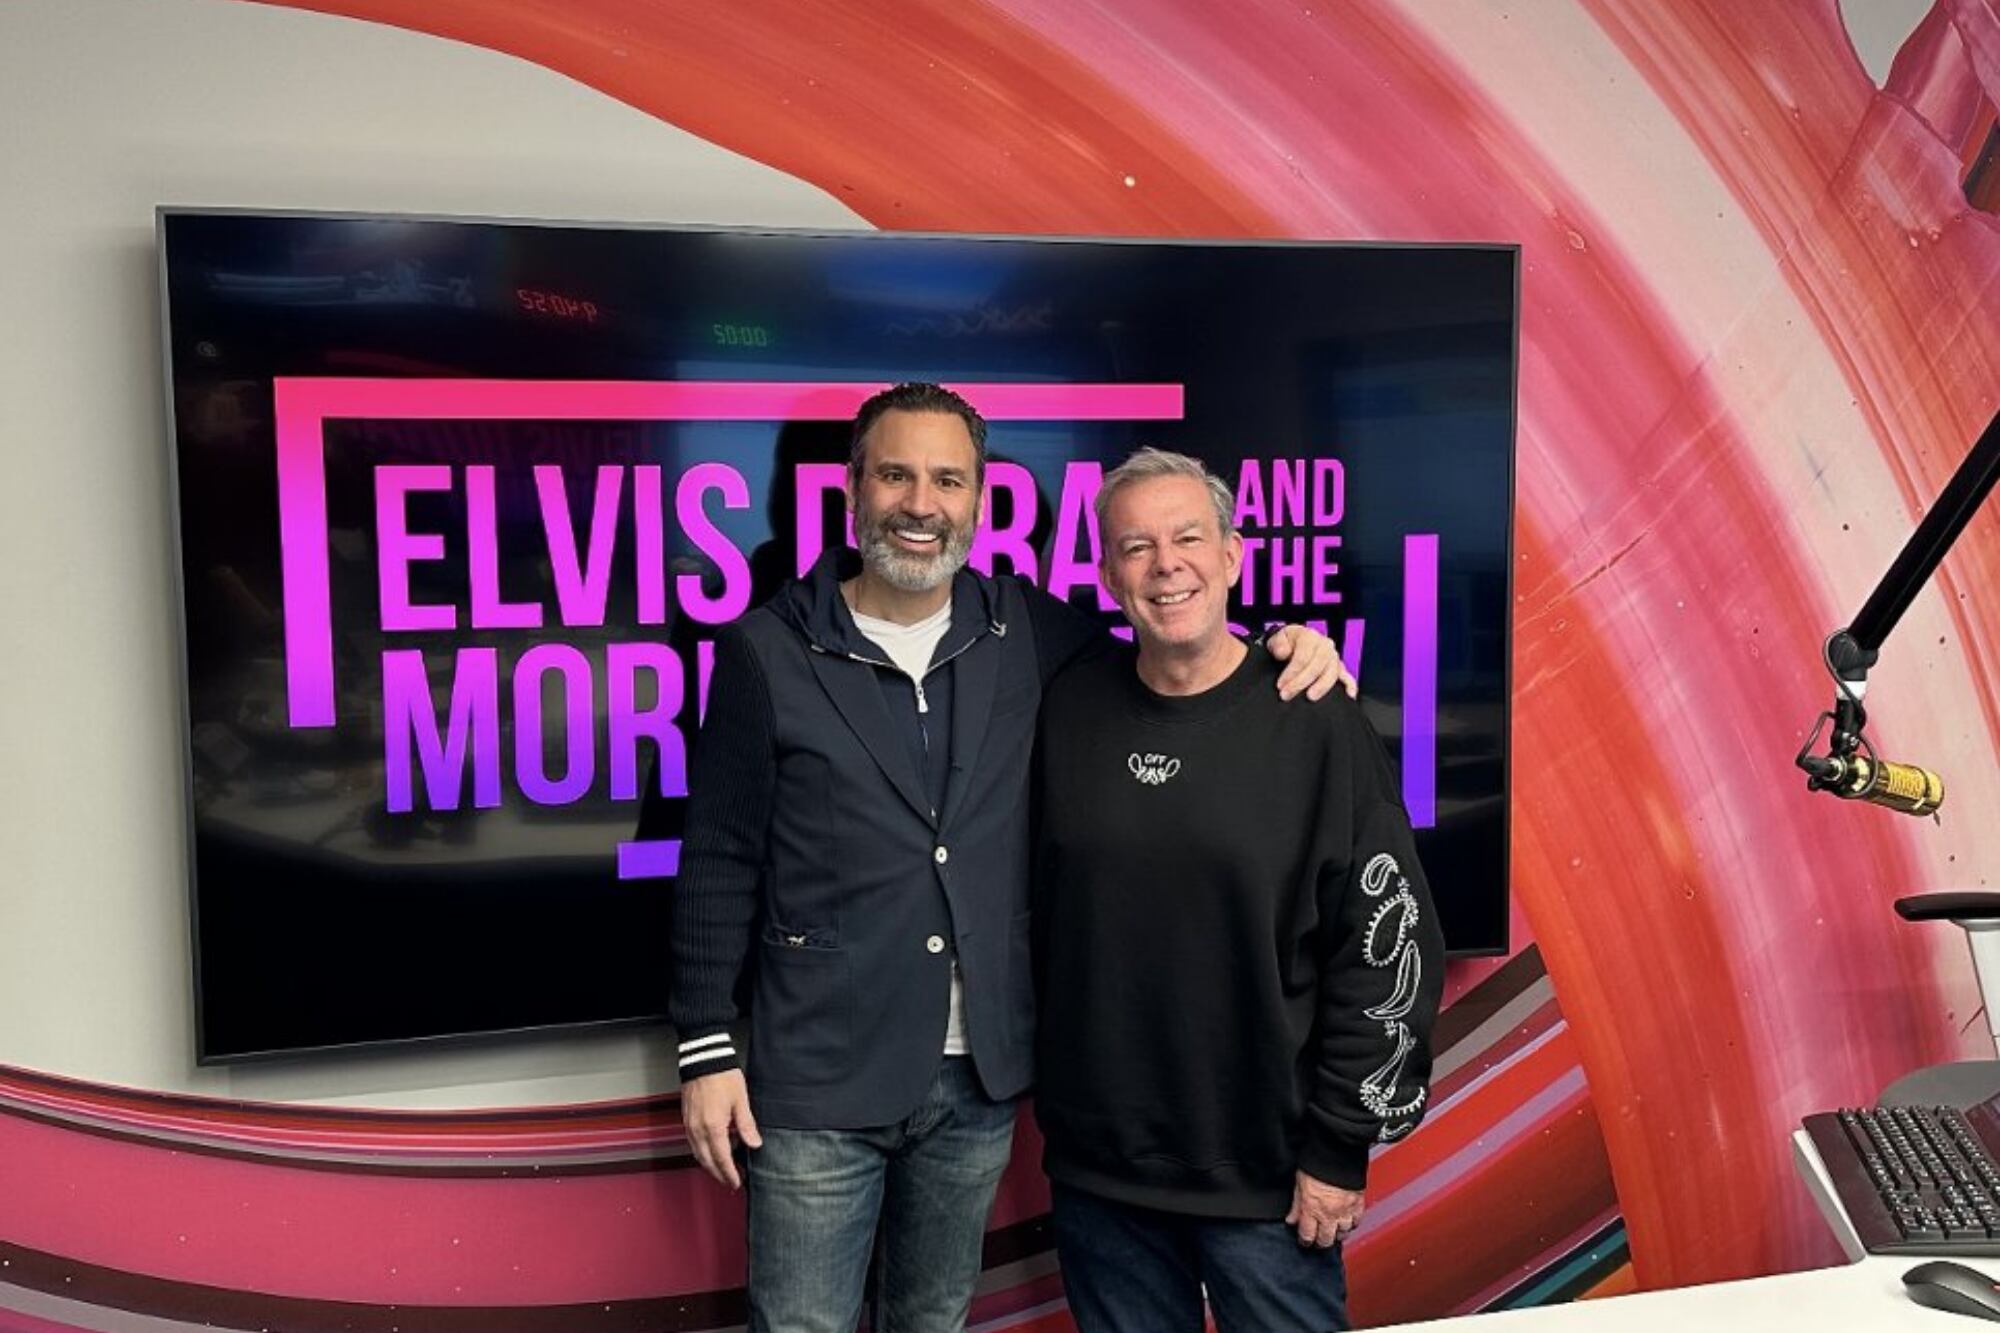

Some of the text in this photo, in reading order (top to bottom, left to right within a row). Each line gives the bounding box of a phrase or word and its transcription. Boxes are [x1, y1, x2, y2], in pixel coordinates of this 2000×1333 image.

[1232, 459, 1345, 527] AND
[375, 463, 751, 631] ELVIS
[1241, 536, 1342, 606] THE
